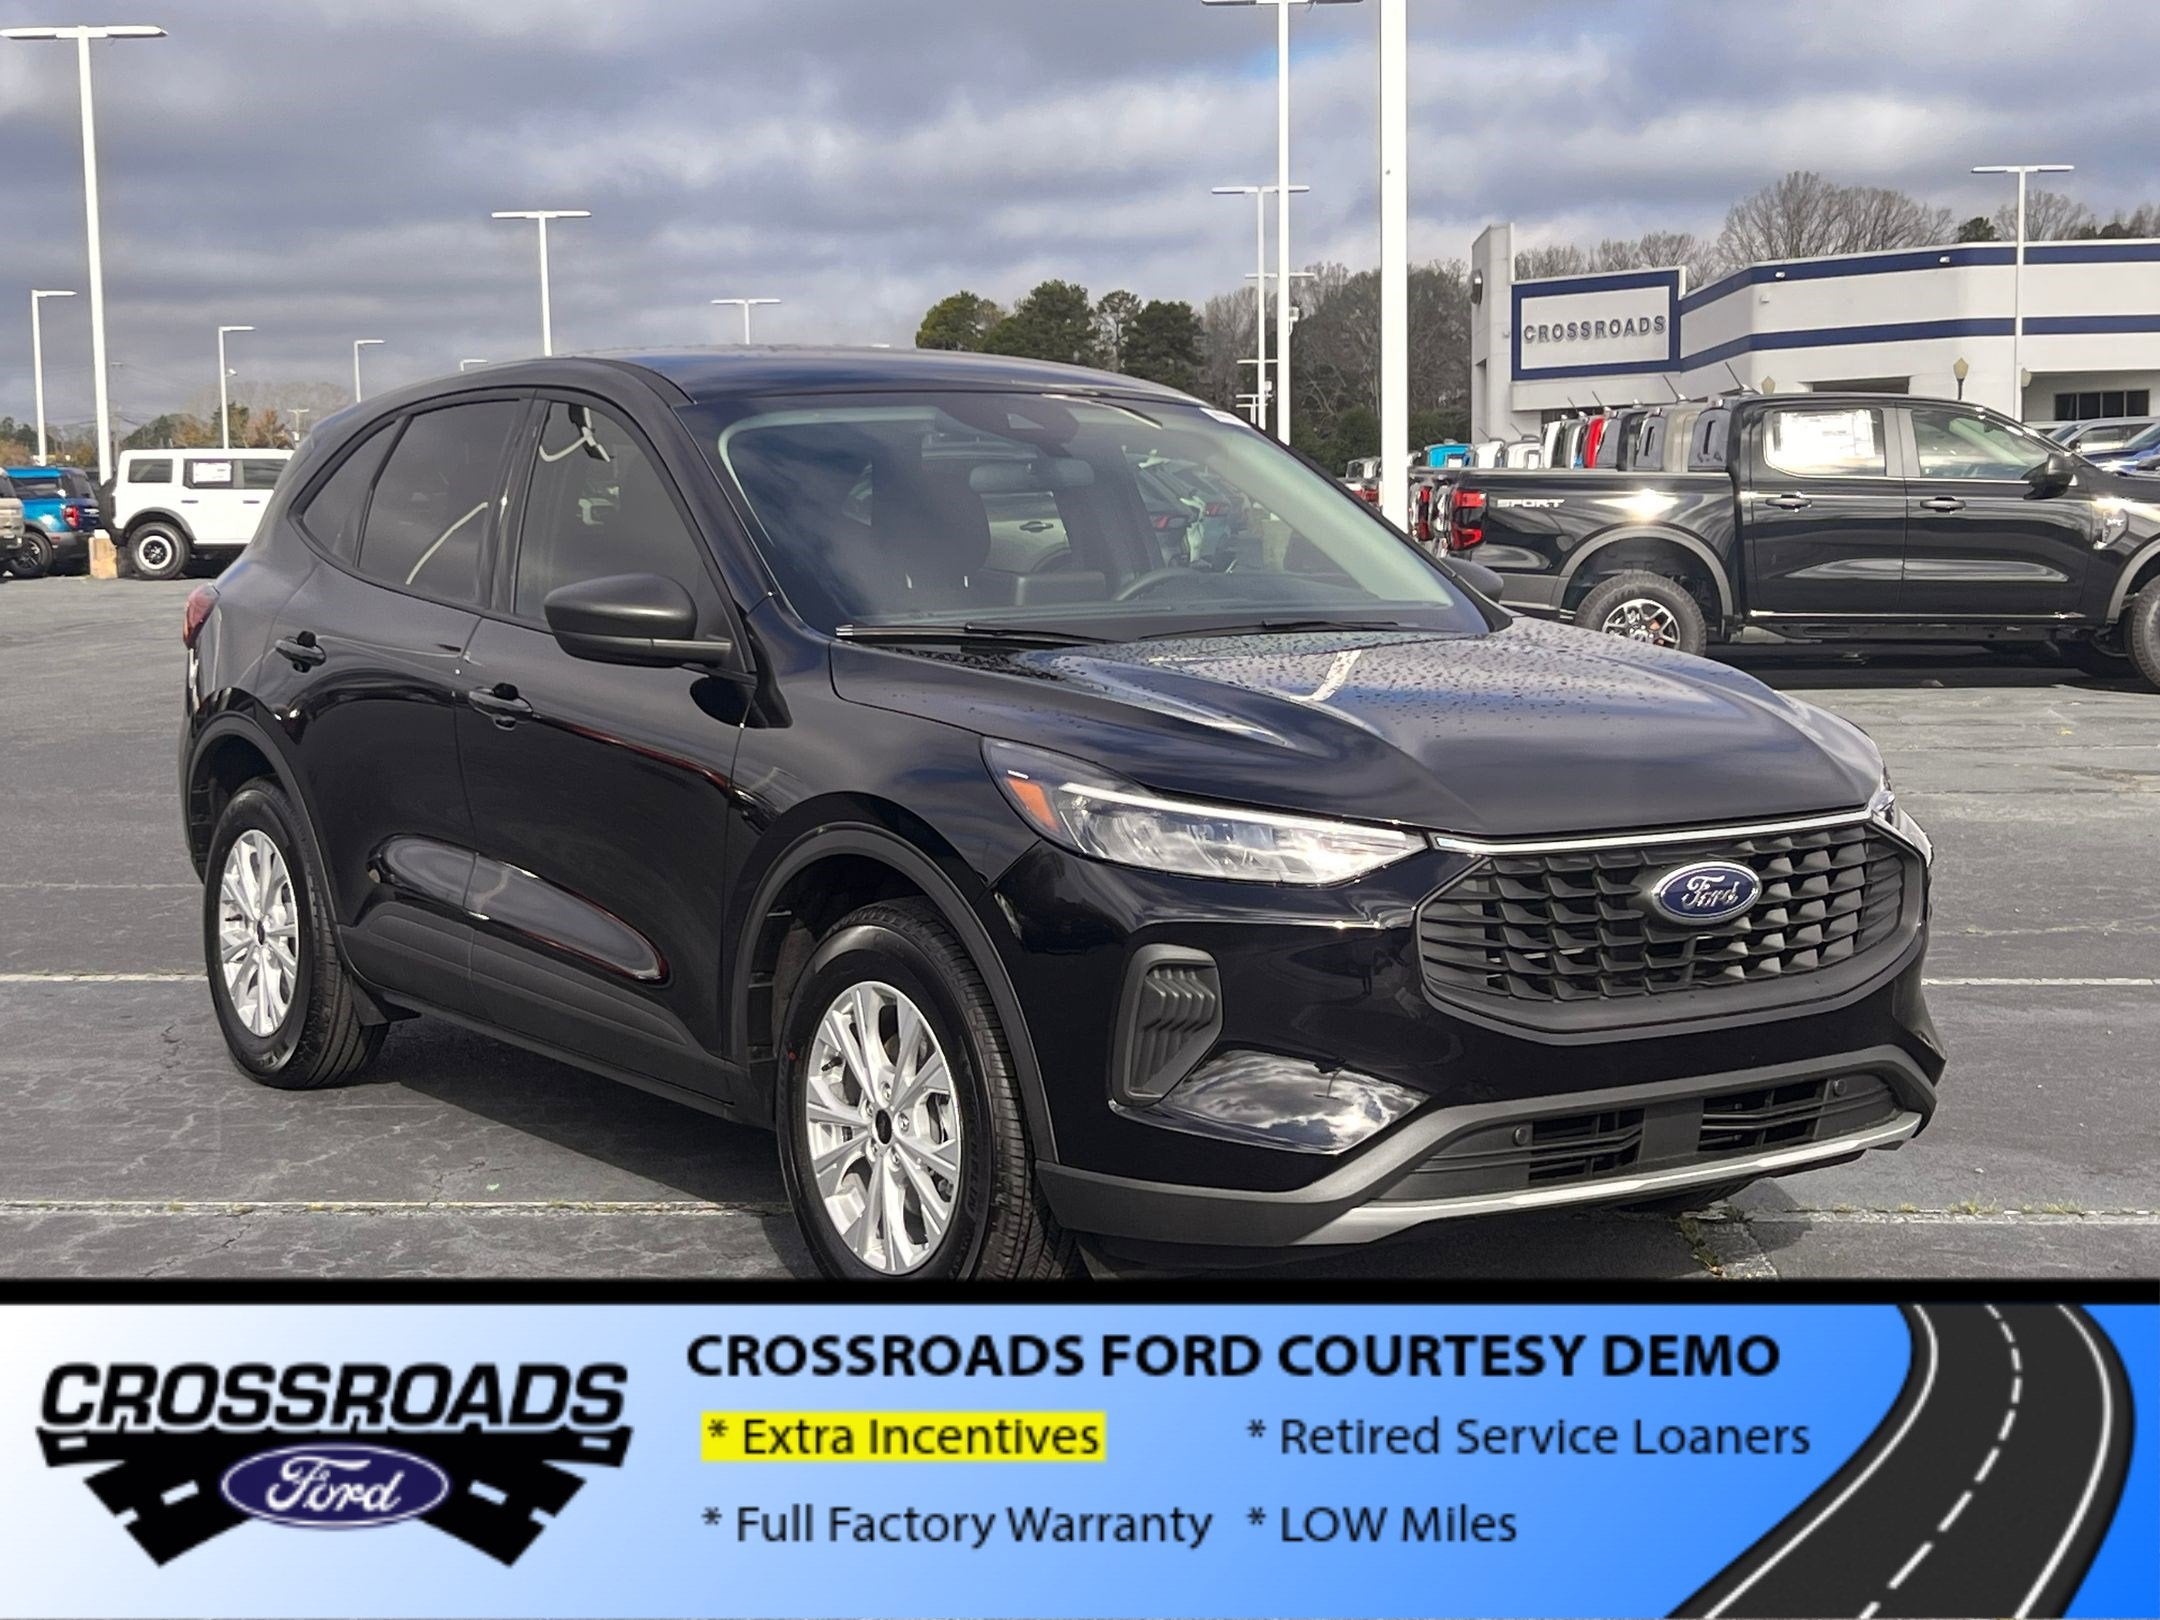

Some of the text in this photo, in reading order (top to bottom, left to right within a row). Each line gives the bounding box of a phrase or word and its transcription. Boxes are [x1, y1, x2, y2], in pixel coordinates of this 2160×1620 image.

[1523, 315, 1667, 343] CROSSROADS
[1496, 499, 1566, 508] SPORT
[1681, 875, 1740, 909] Ford
